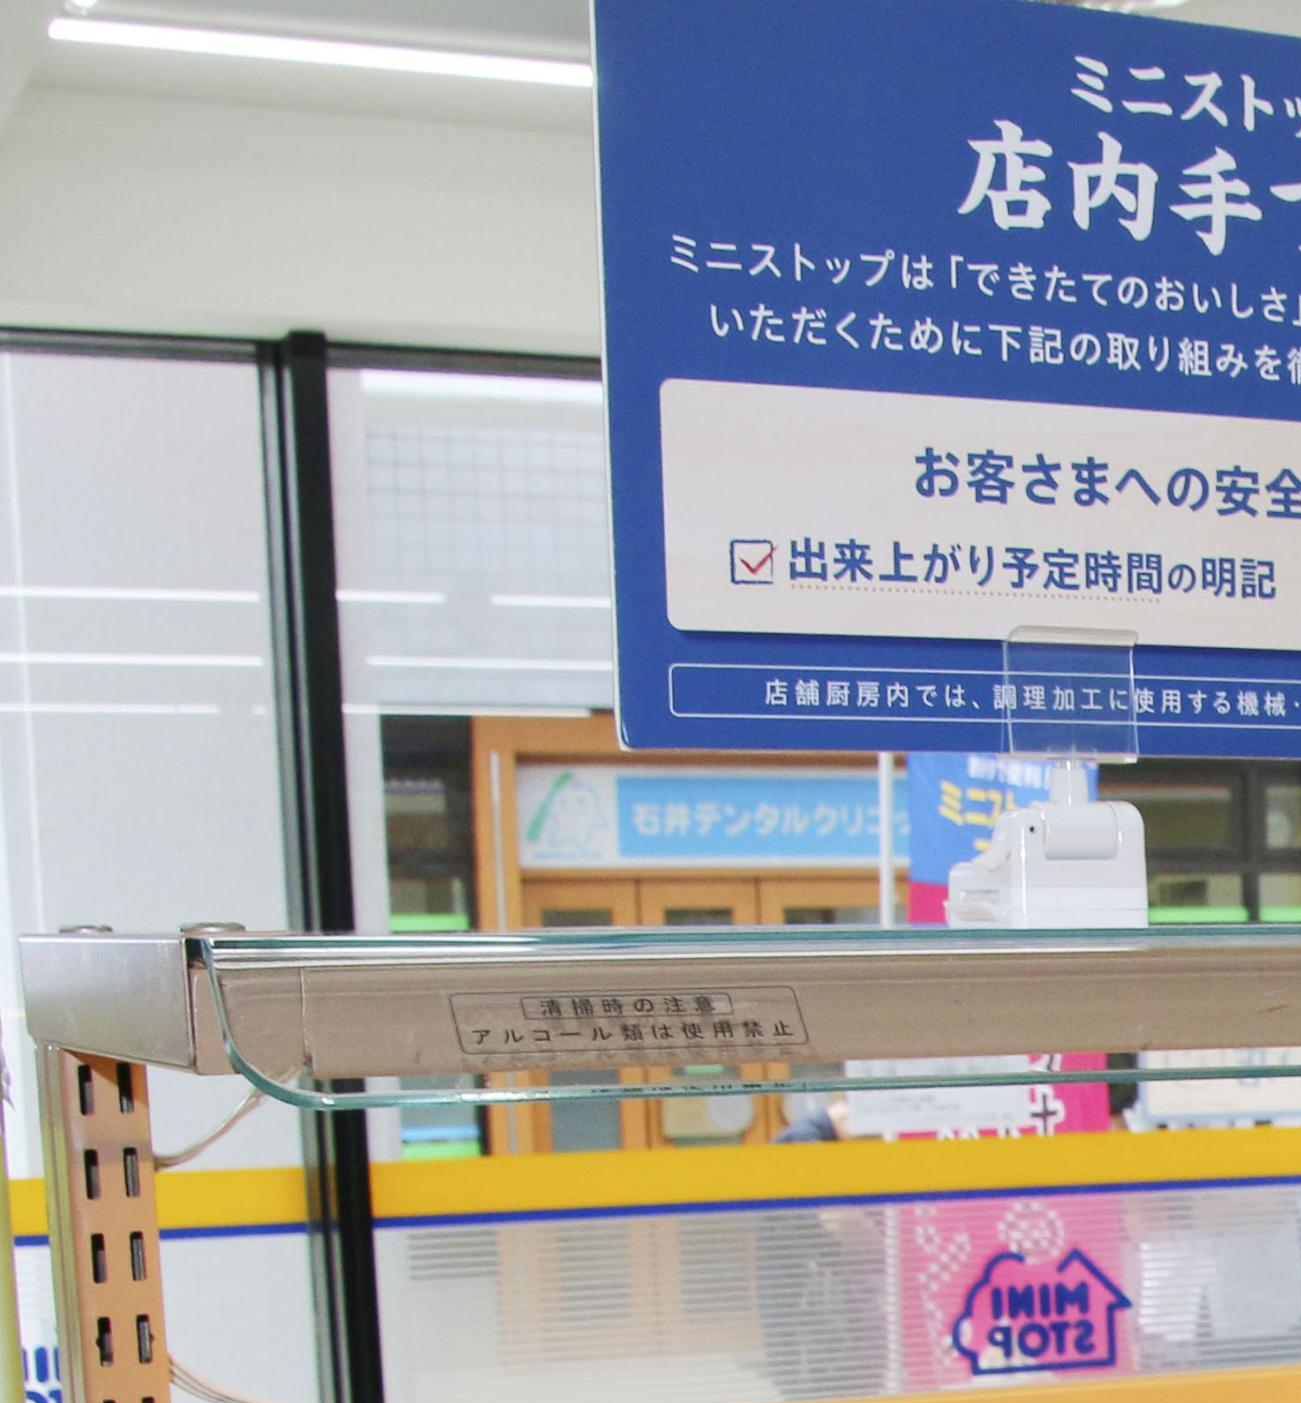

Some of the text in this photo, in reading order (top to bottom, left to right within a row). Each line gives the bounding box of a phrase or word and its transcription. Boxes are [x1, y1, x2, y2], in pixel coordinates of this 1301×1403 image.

[788, 538, 1276, 600] 出来上がり予定時間の明記
[541, 995, 717, 1017] 清掃時の注意
[471, 1020, 795, 1045] アルコール類は使用禁止
